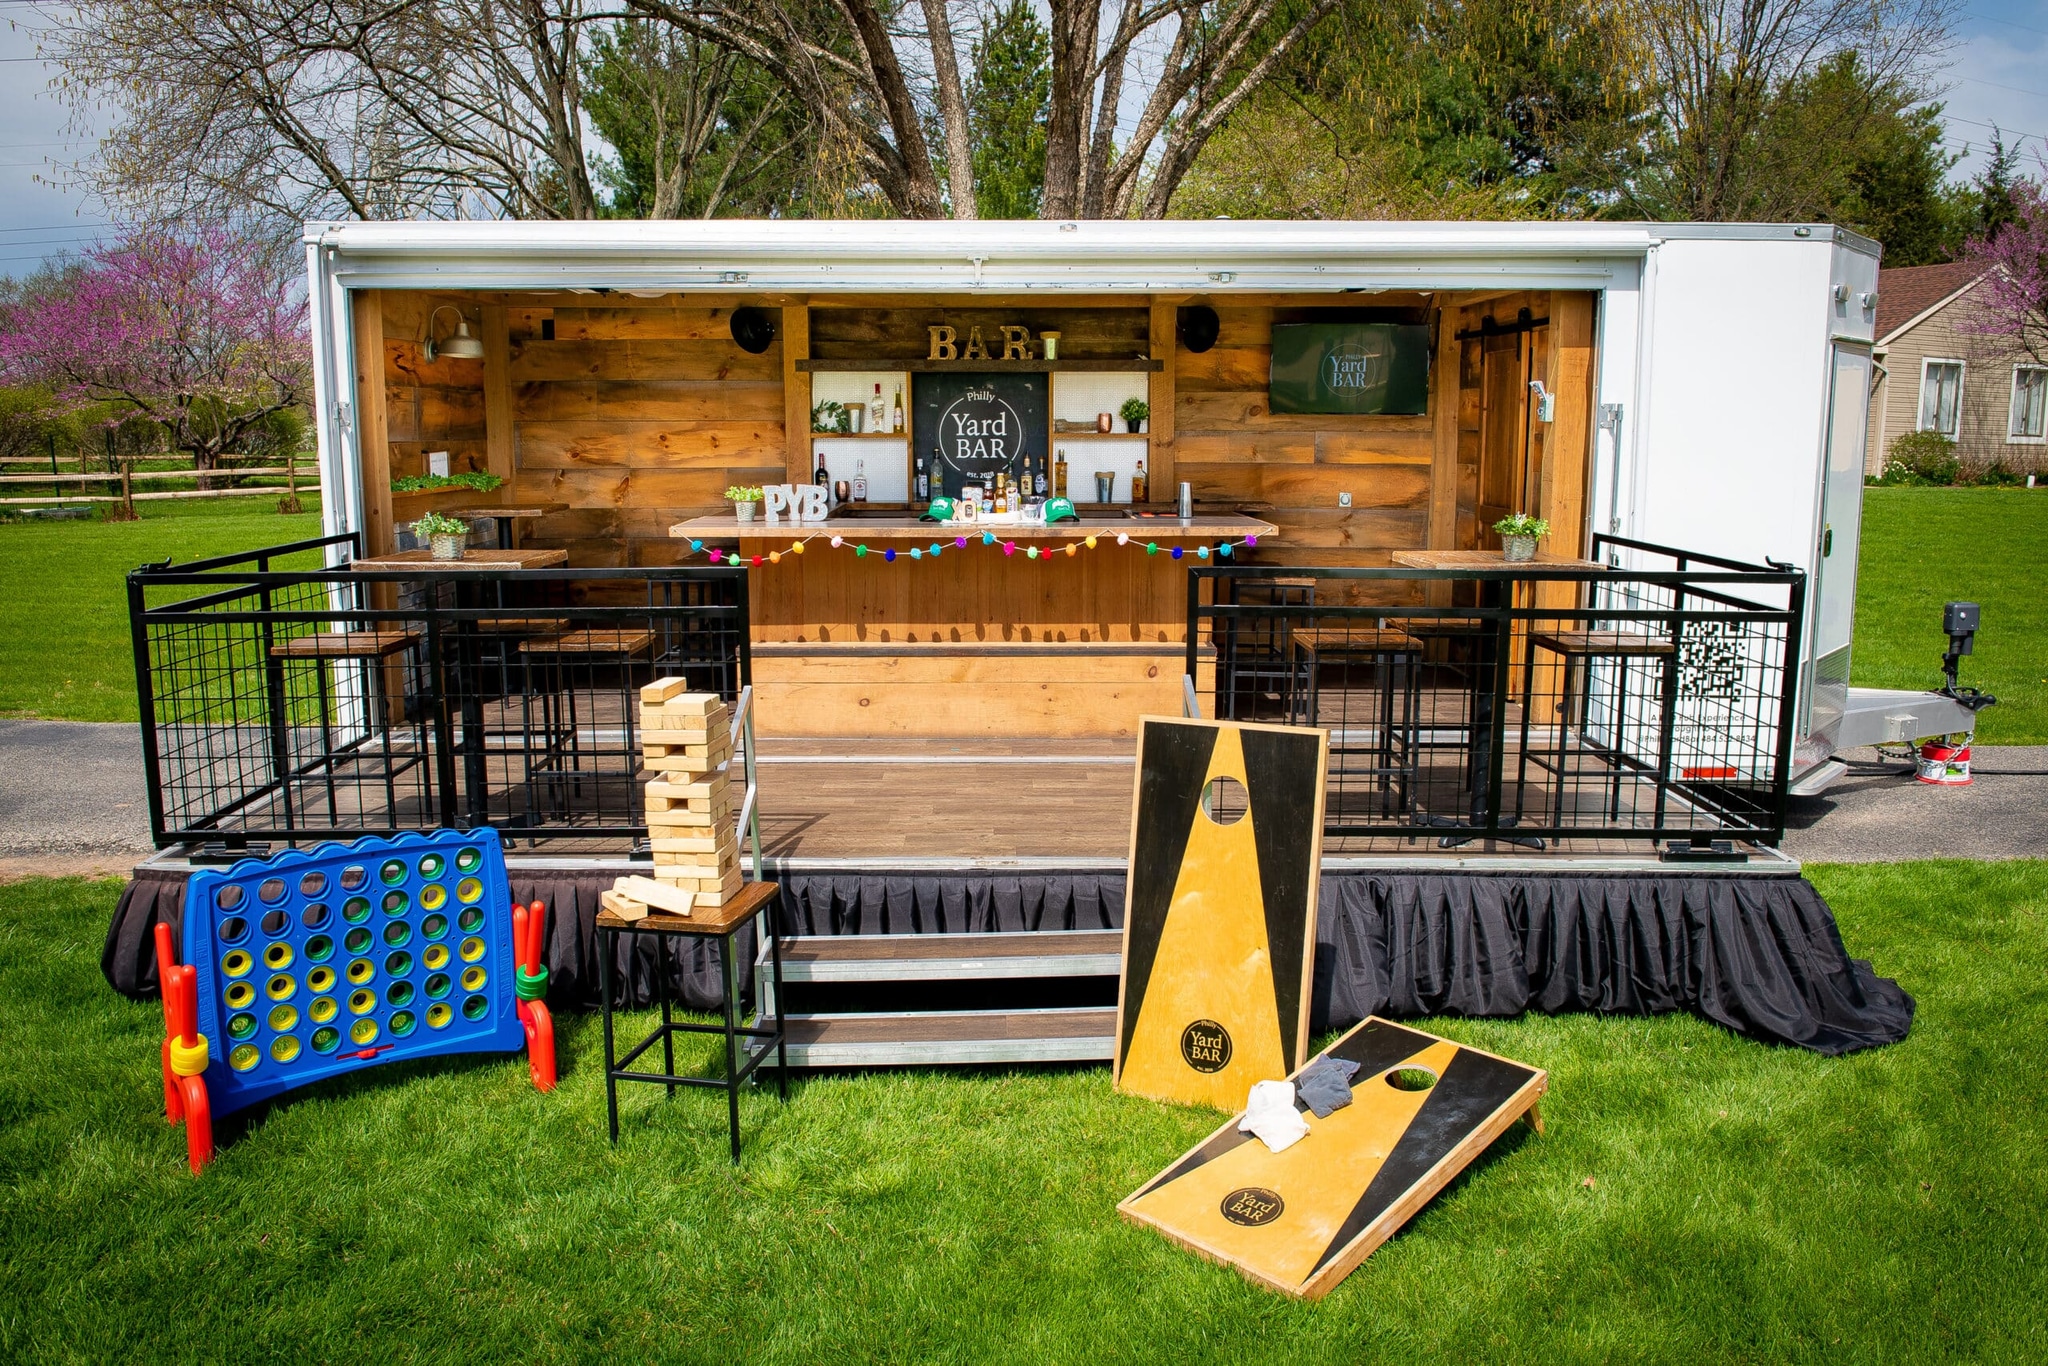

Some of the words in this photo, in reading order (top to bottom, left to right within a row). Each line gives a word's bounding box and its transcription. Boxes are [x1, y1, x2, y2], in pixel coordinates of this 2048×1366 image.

[927, 325, 1033, 360] BAR
[1329, 355, 1367, 373] Yard
[1333, 372, 1367, 388] BAR
[966, 391, 996, 404] Philly
[951, 411, 1008, 436] Yard
[956, 439, 1008, 460] BAR
[762, 484, 829, 522] PYB
[1190, 1031, 1222, 1050] Yard
[1191, 1046, 1222, 1063] BAR
[1229, 1202, 1264, 1221] BAR
[1239, 1192, 1276, 1214] Yard
